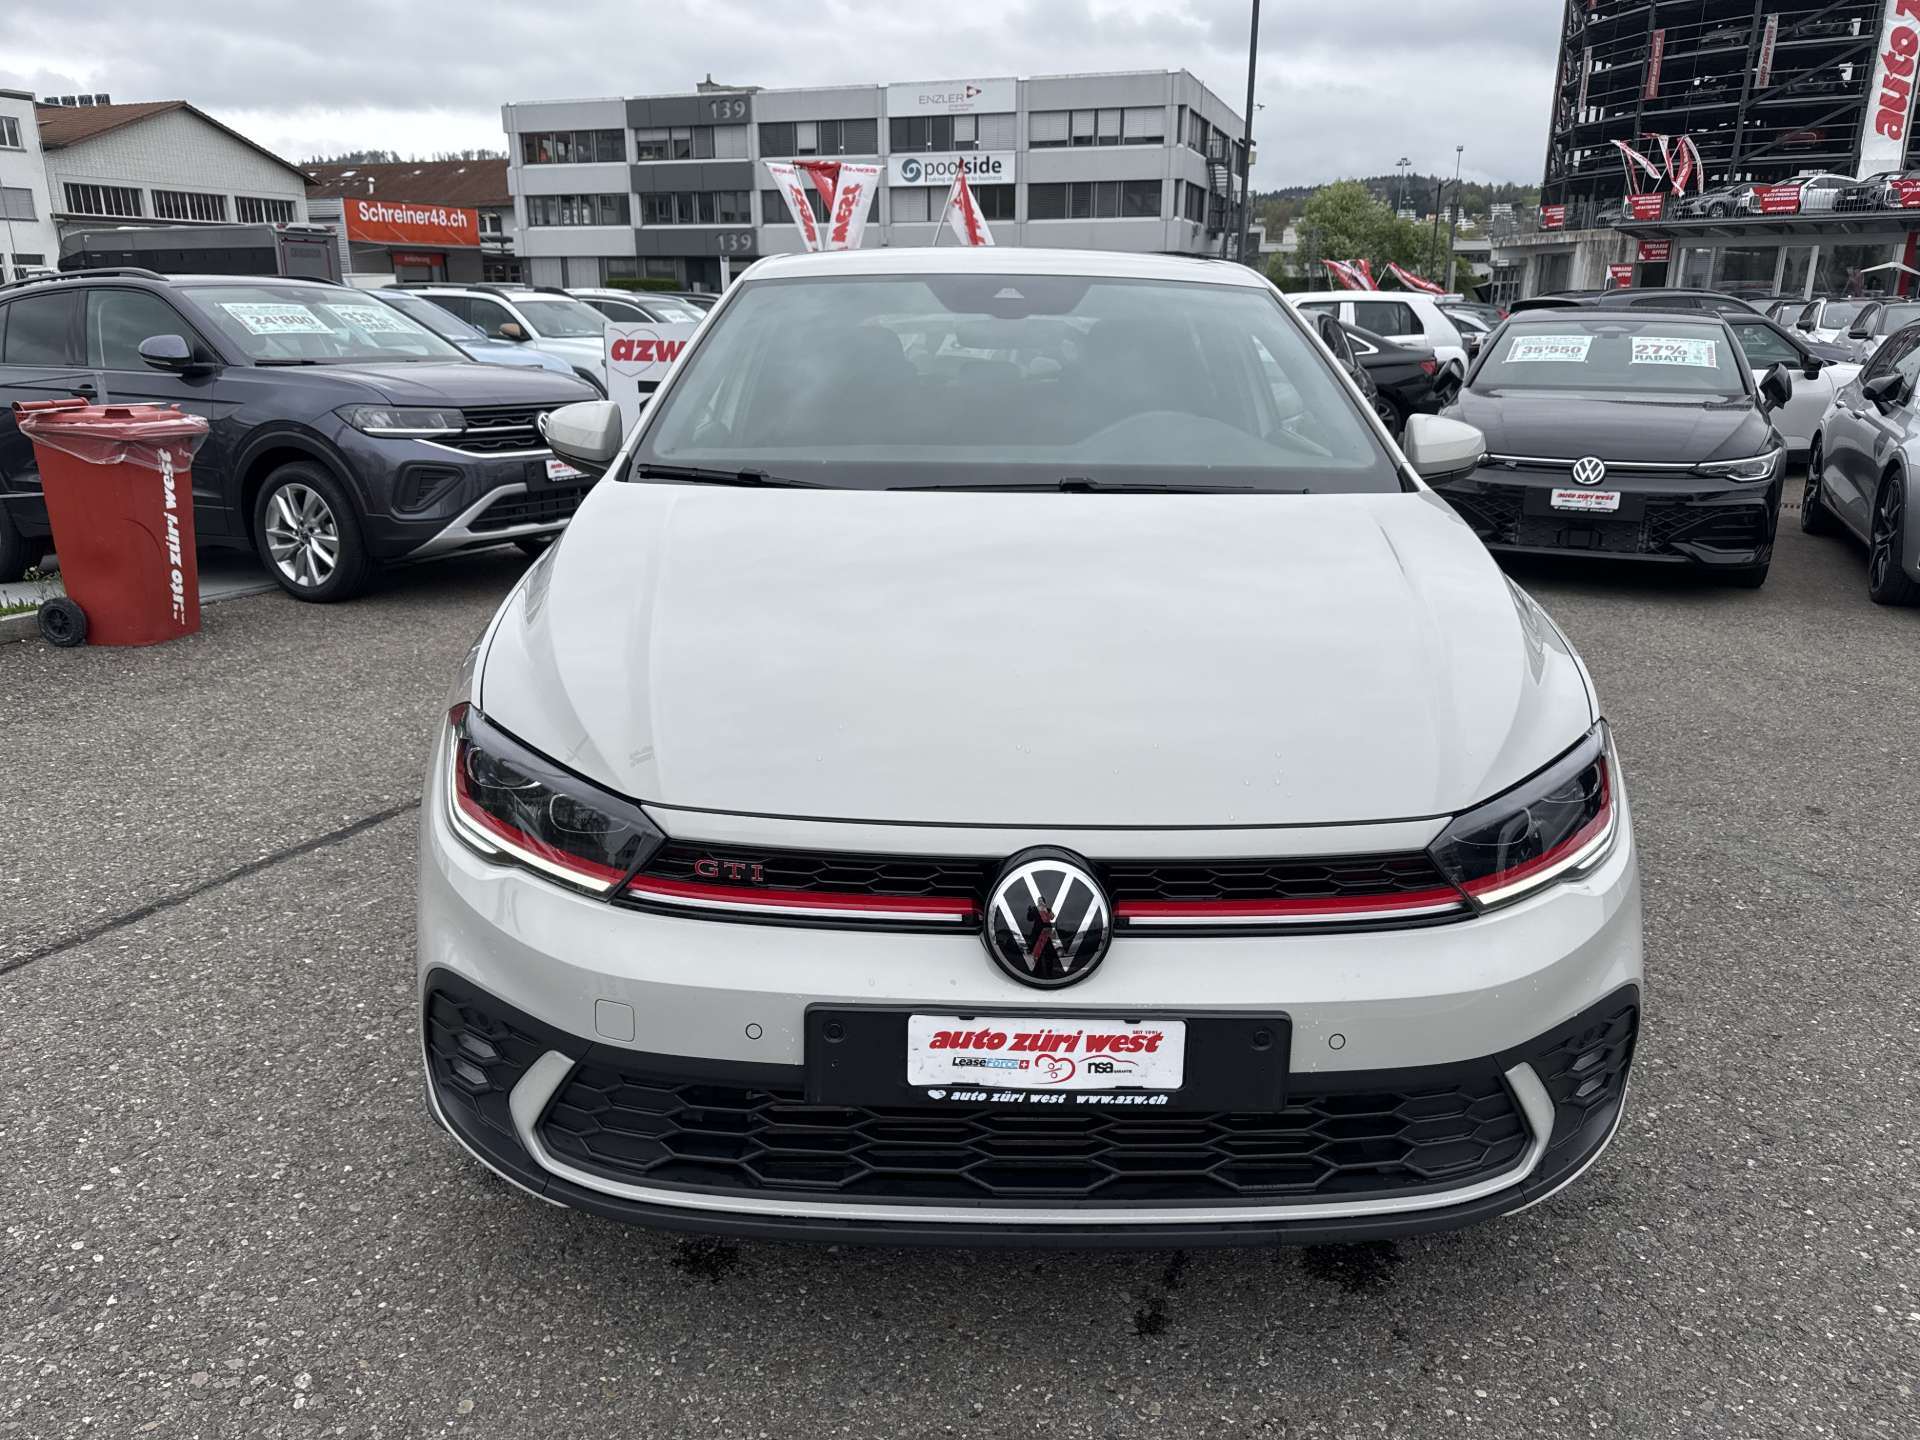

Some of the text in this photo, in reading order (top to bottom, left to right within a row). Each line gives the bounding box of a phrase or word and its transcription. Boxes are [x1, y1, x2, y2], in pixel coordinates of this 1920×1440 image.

[1875, 26, 1918, 140] auto
[918, 93, 965, 104] ENZLER
[709, 100, 746, 119] 139
[924, 155, 1002, 182] pooside
[358, 201, 468, 228] Schreiner48.ch
[715, 233, 752, 251] 139
[610, 338, 688, 362] azw
[1522, 345, 1582, 355] 35'550
[1634, 344, 1688, 356] 27%
[1634, 354, 1688, 362] RABATT
[158, 448, 177, 509] west
[163, 512, 183, 567] züri
[694, 859, 764, 882] GTI
[929, 1027, 1164, 1053] auto züri west
[952, 1056, 1018, 1070] LeaseForce
[1087, 1061, 1114, 1074] nsa
[950, 1090, 1169, 1105] auto züri west www.azw.ch
